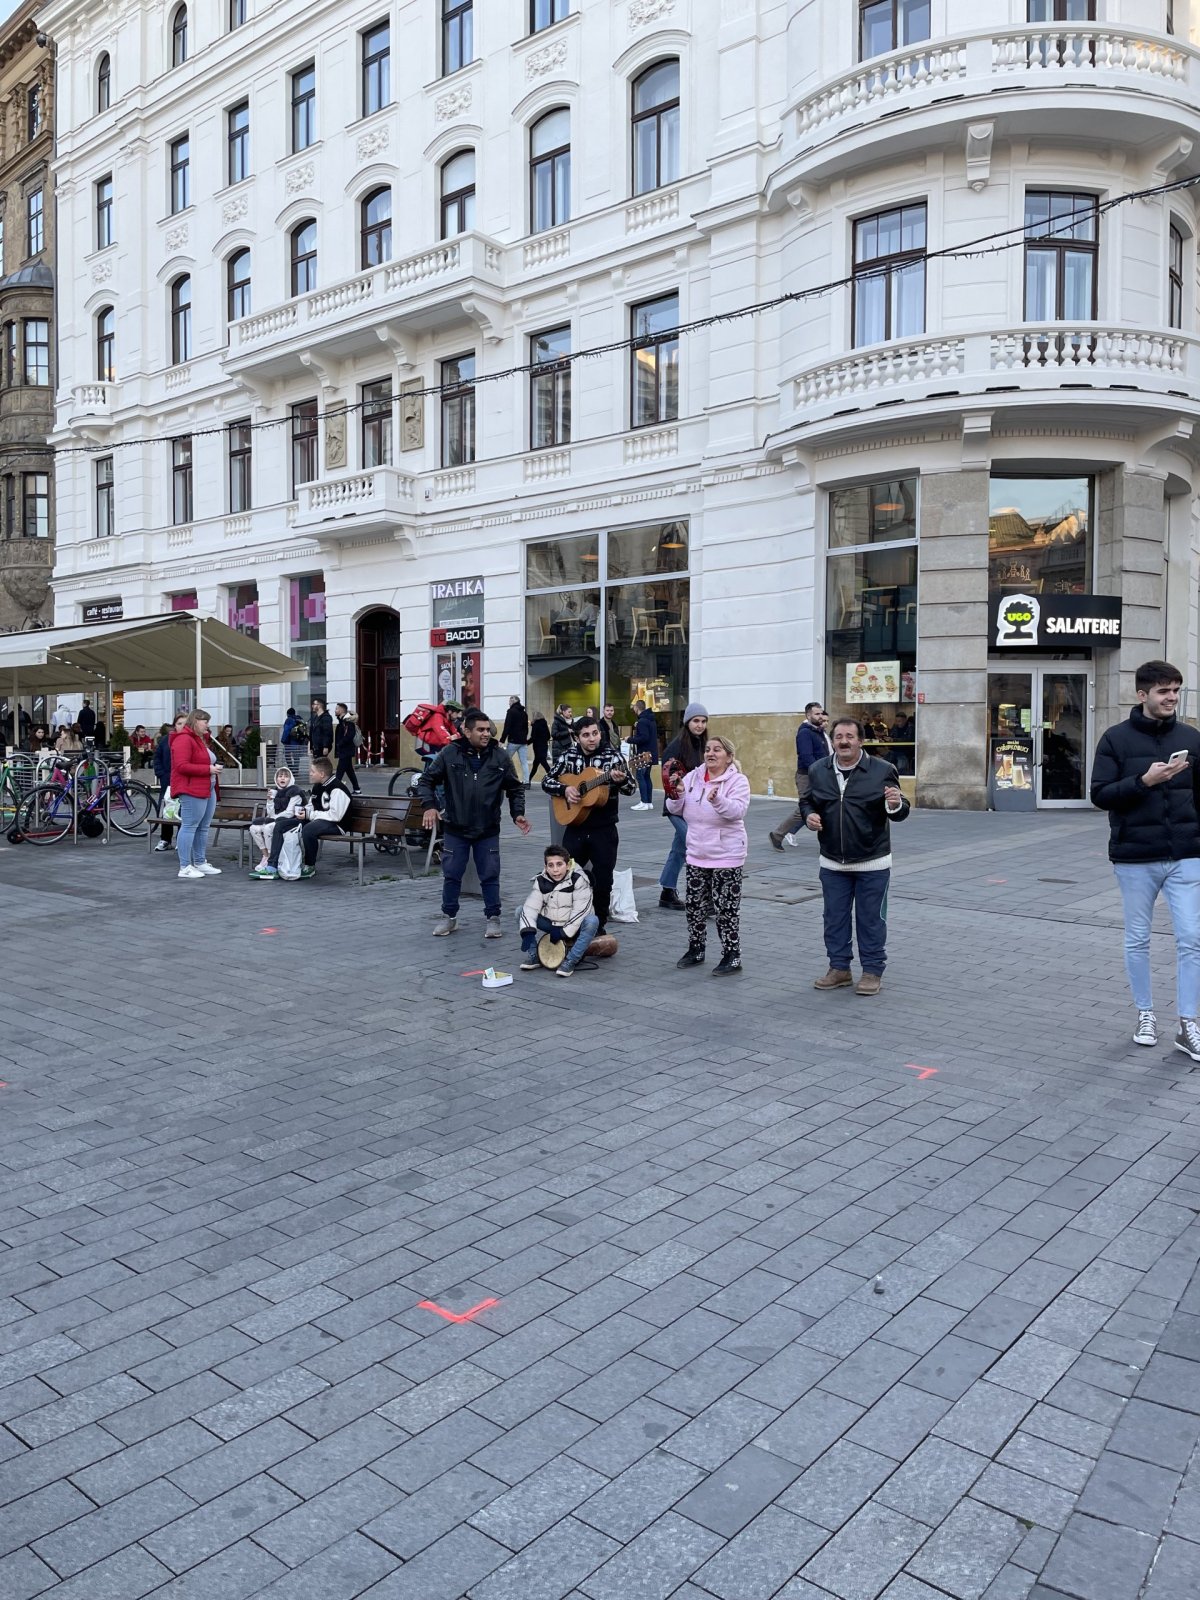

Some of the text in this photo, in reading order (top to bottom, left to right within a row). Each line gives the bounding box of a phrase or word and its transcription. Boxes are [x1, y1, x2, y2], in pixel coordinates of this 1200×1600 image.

[431, 580, 484, 599] TRAFIKA
[1007, 612, 1032, 622] UGO
[1046, 617, 1120, 635] SALATERIE
[432, 630, 480, 643] TOBACCO
[462, 656, 474, 669] glo
